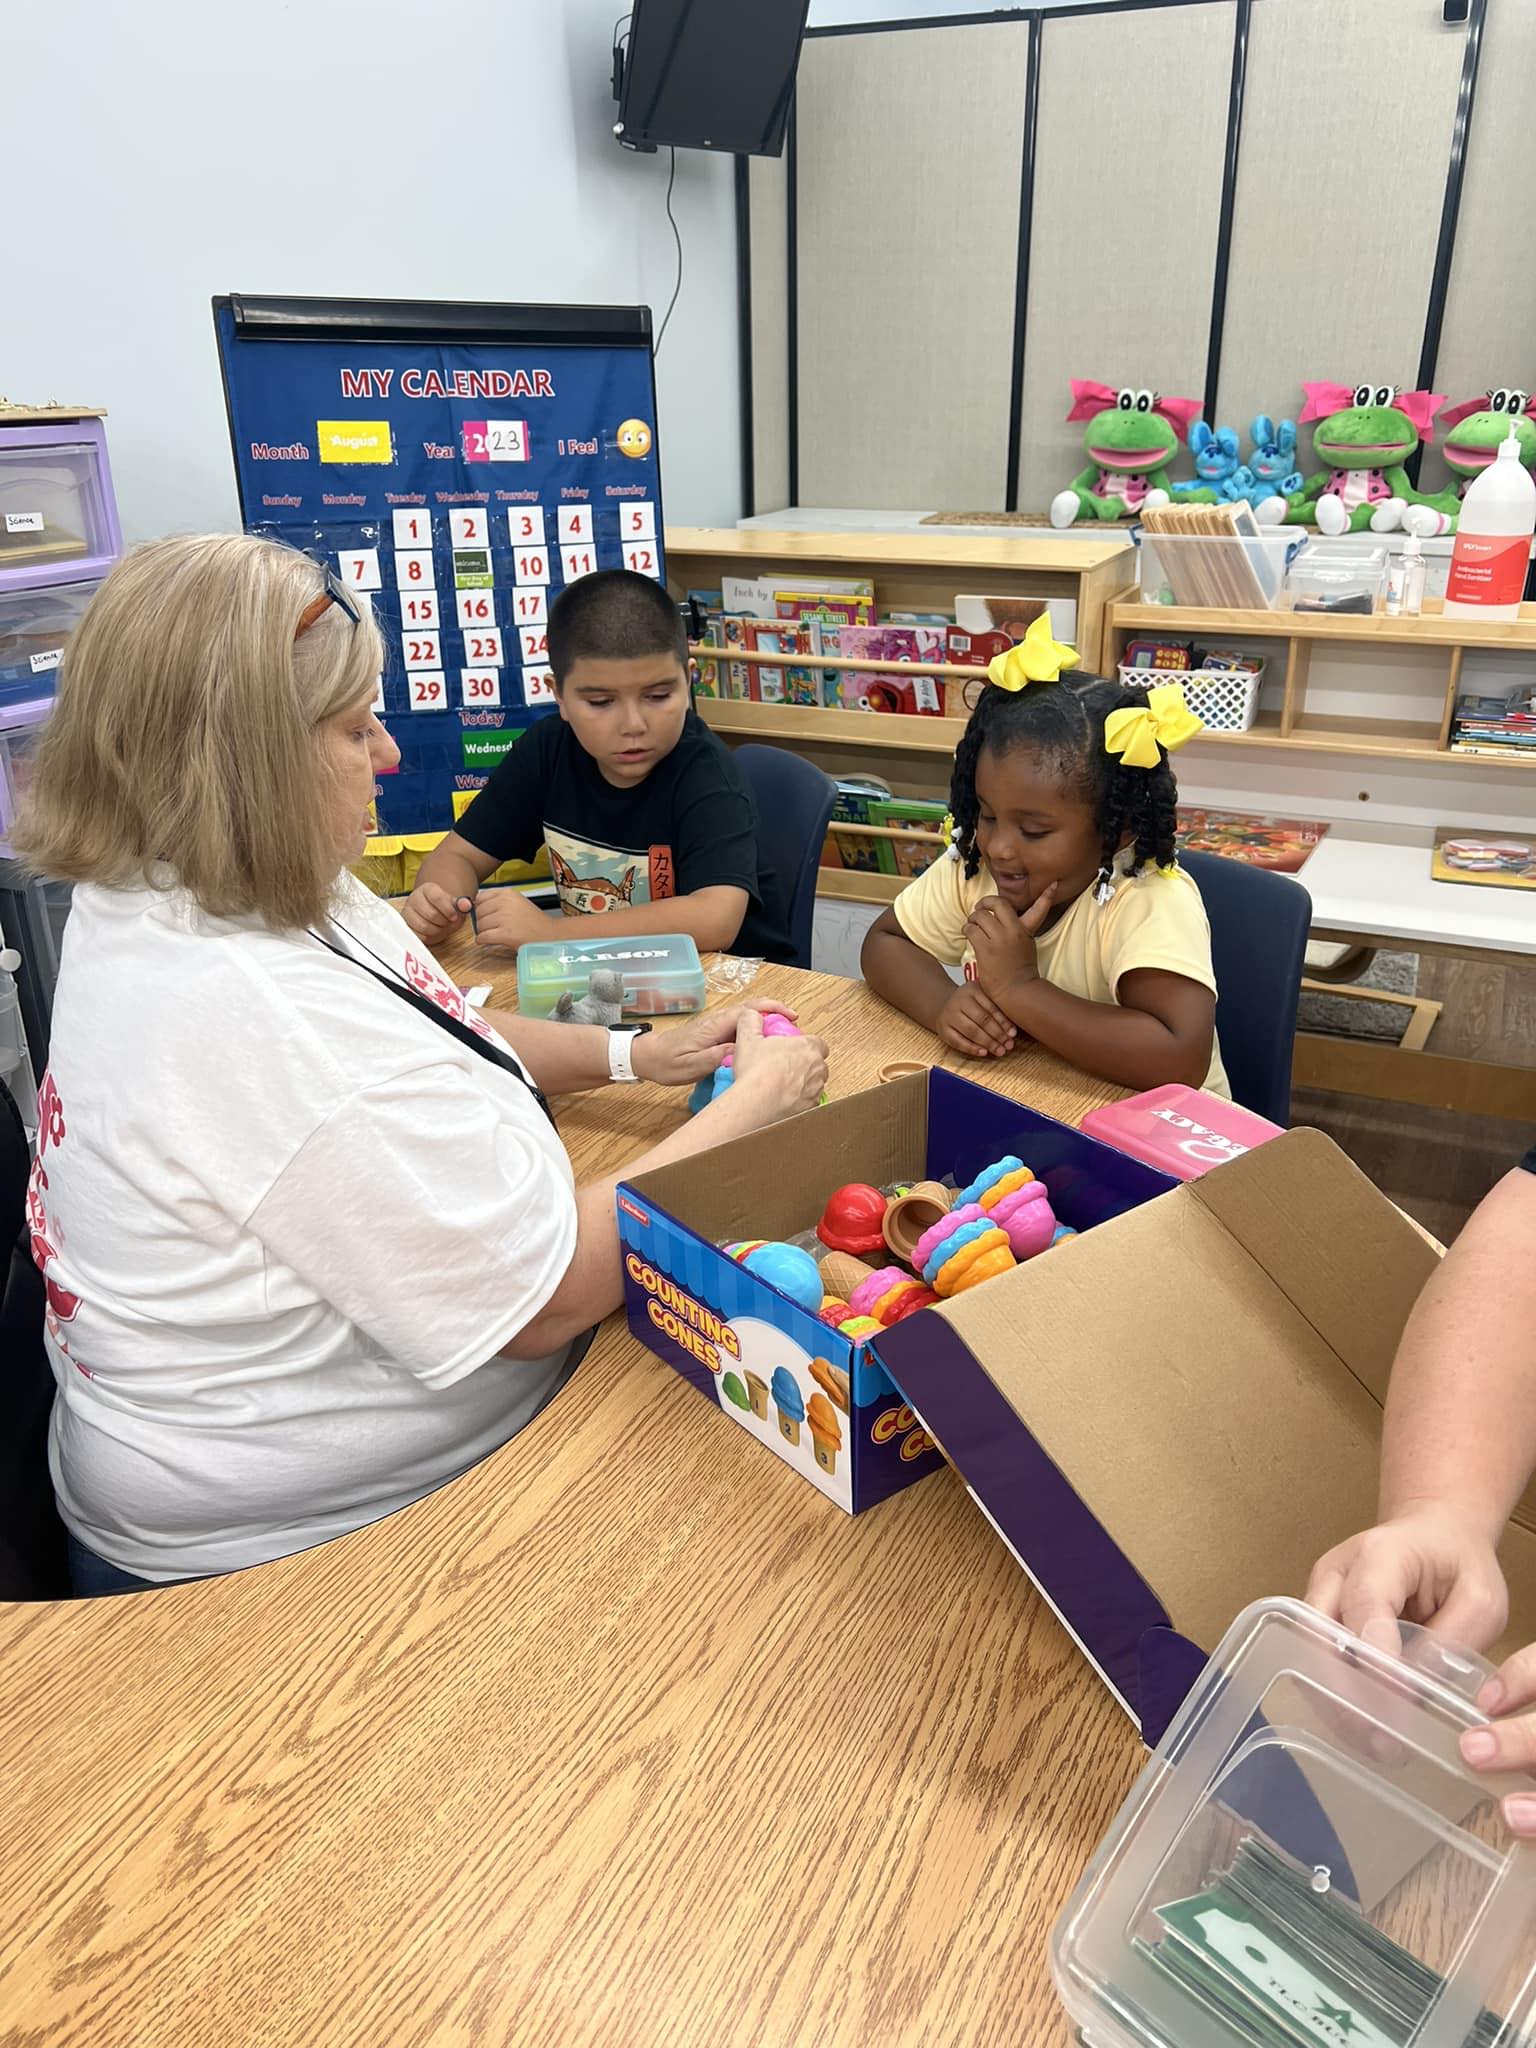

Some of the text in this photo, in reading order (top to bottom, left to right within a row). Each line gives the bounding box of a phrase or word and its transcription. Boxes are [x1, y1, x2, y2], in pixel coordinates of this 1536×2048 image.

[340, 368, 555, 398] MY CALENDAR
[251, 442, 309, 460] Month
[558, 438, 599, 455] I Feel
[262, 484, 647, 507] Sunday Monday Tuesday Wednesday Thursday Friday Saturday
[8, 515, 35, 526] Science
[409, 511, 643, 539] 1 2 3 4 5
[353, 550, 652, 581] 7 8 10 11 12
[407, 596, 540, 620] 15 16 17
[32, 652, 58, 665] Science
[409, 641, 435, 661] 22
[471, 638, 498, 658] 23
[415, 682, 441, 701] 29
[468, 678, 494, 697] 30
[459, 711, 505, 727] Today
[465, 741, 513, 754] Wednesd
[558, 949, 671, 964] CARSON
[626, 1253, 741, 1361] COUNTING
[647, 1298, 722, 1374] CONES
[784, 1424, 792, 1437] 2
[820, 1452, 828, 1465] 3
